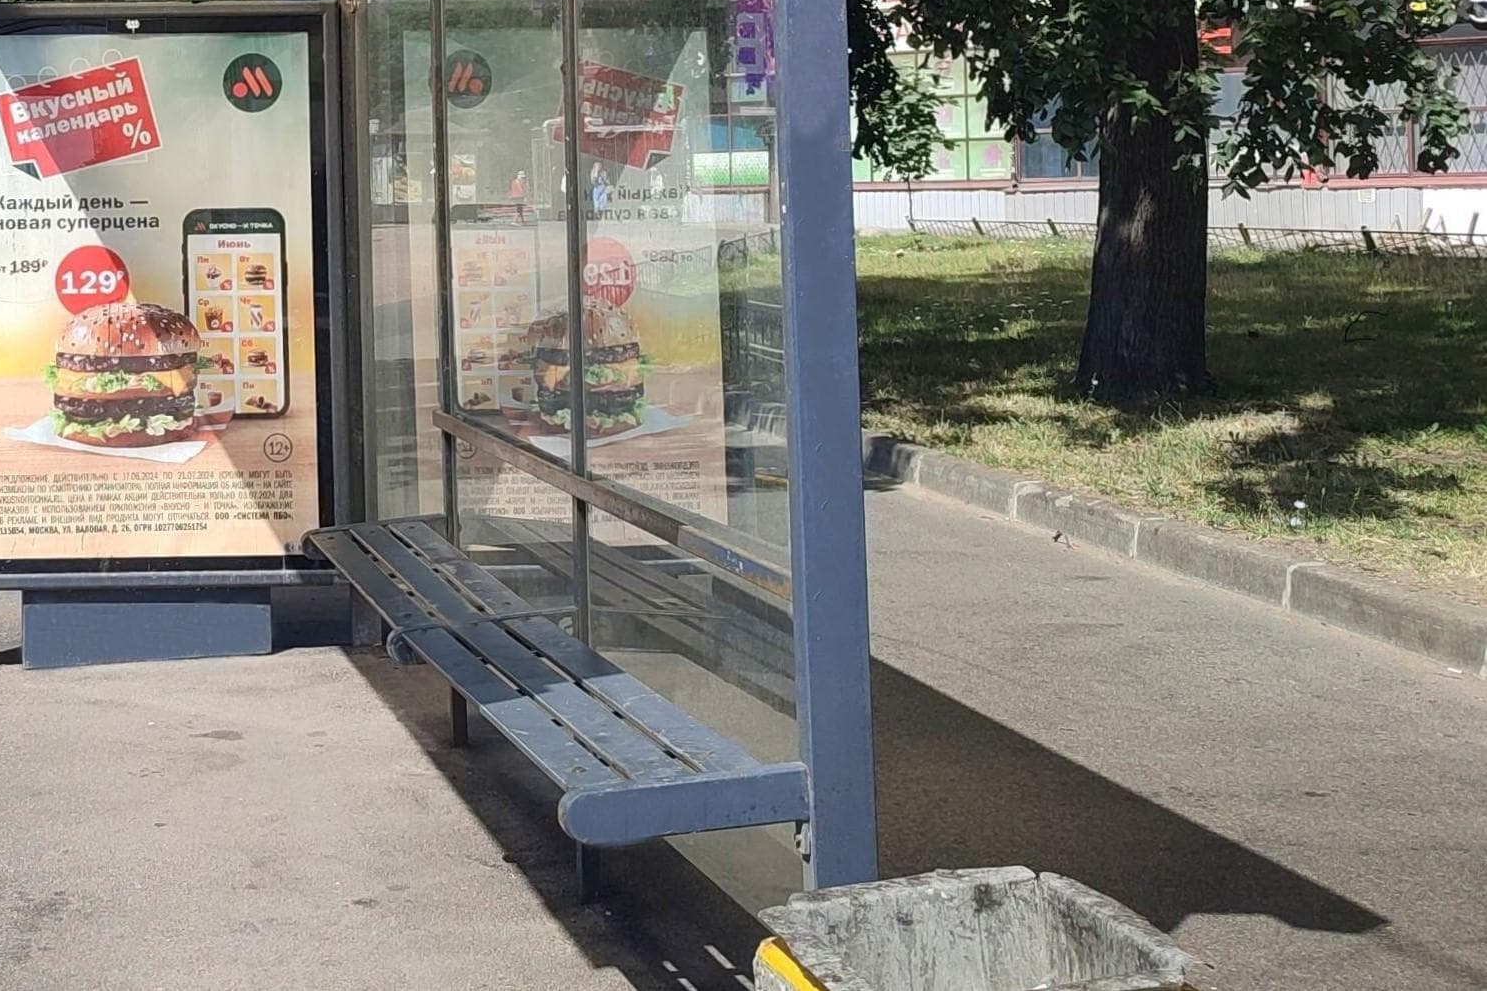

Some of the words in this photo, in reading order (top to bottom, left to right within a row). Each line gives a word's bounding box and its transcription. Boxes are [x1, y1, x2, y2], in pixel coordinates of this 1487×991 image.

[10, 72, 134, 124] Вкусный
[16, 102, 138, 145] календарь
[78, 197, 124, 212] день
[57, 216, 160, 233] суперцена
[217, 240, 251, 249] Июнь
[198, 299, 209, 307] Ср
[268, 441, 289, 456] 12+
[53, 473, 108, 483] ДЕЙСТВИТЕЛЬНО
[249, 471, 270, 479] МОГУТ
[275, 470, 292, 479] БЫТЬ
[215, 513, 229, 521] ООО
[134, 524, 151, 532] ОГРН
